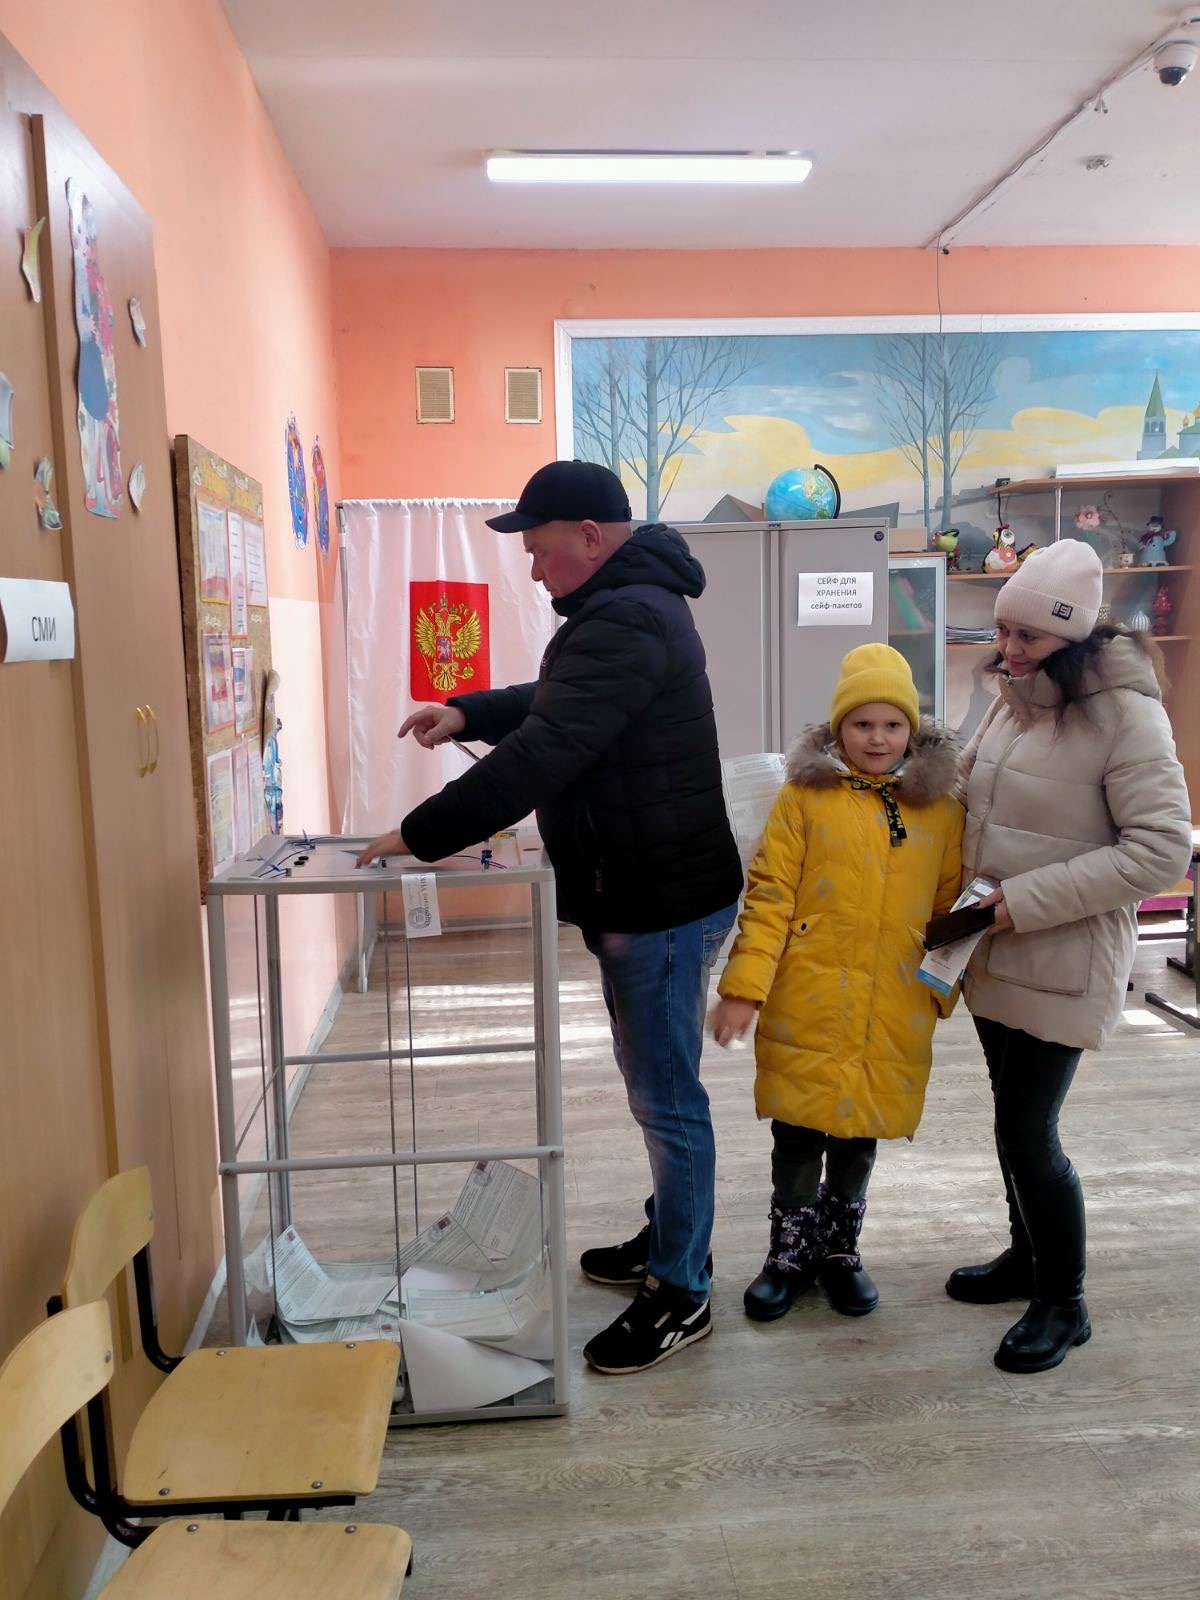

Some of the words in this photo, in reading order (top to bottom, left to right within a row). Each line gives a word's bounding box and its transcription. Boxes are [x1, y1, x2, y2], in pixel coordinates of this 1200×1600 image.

[817, 577, 839, 585] СЕЙФ
[840, 577, 857, 586] ДЛЯ
[816, 589, 857, 597] ХРАНЕНИЯ
[810, 602, 863, 610] сейф-пакетов
[32, 616, 57, 642] СМИ
